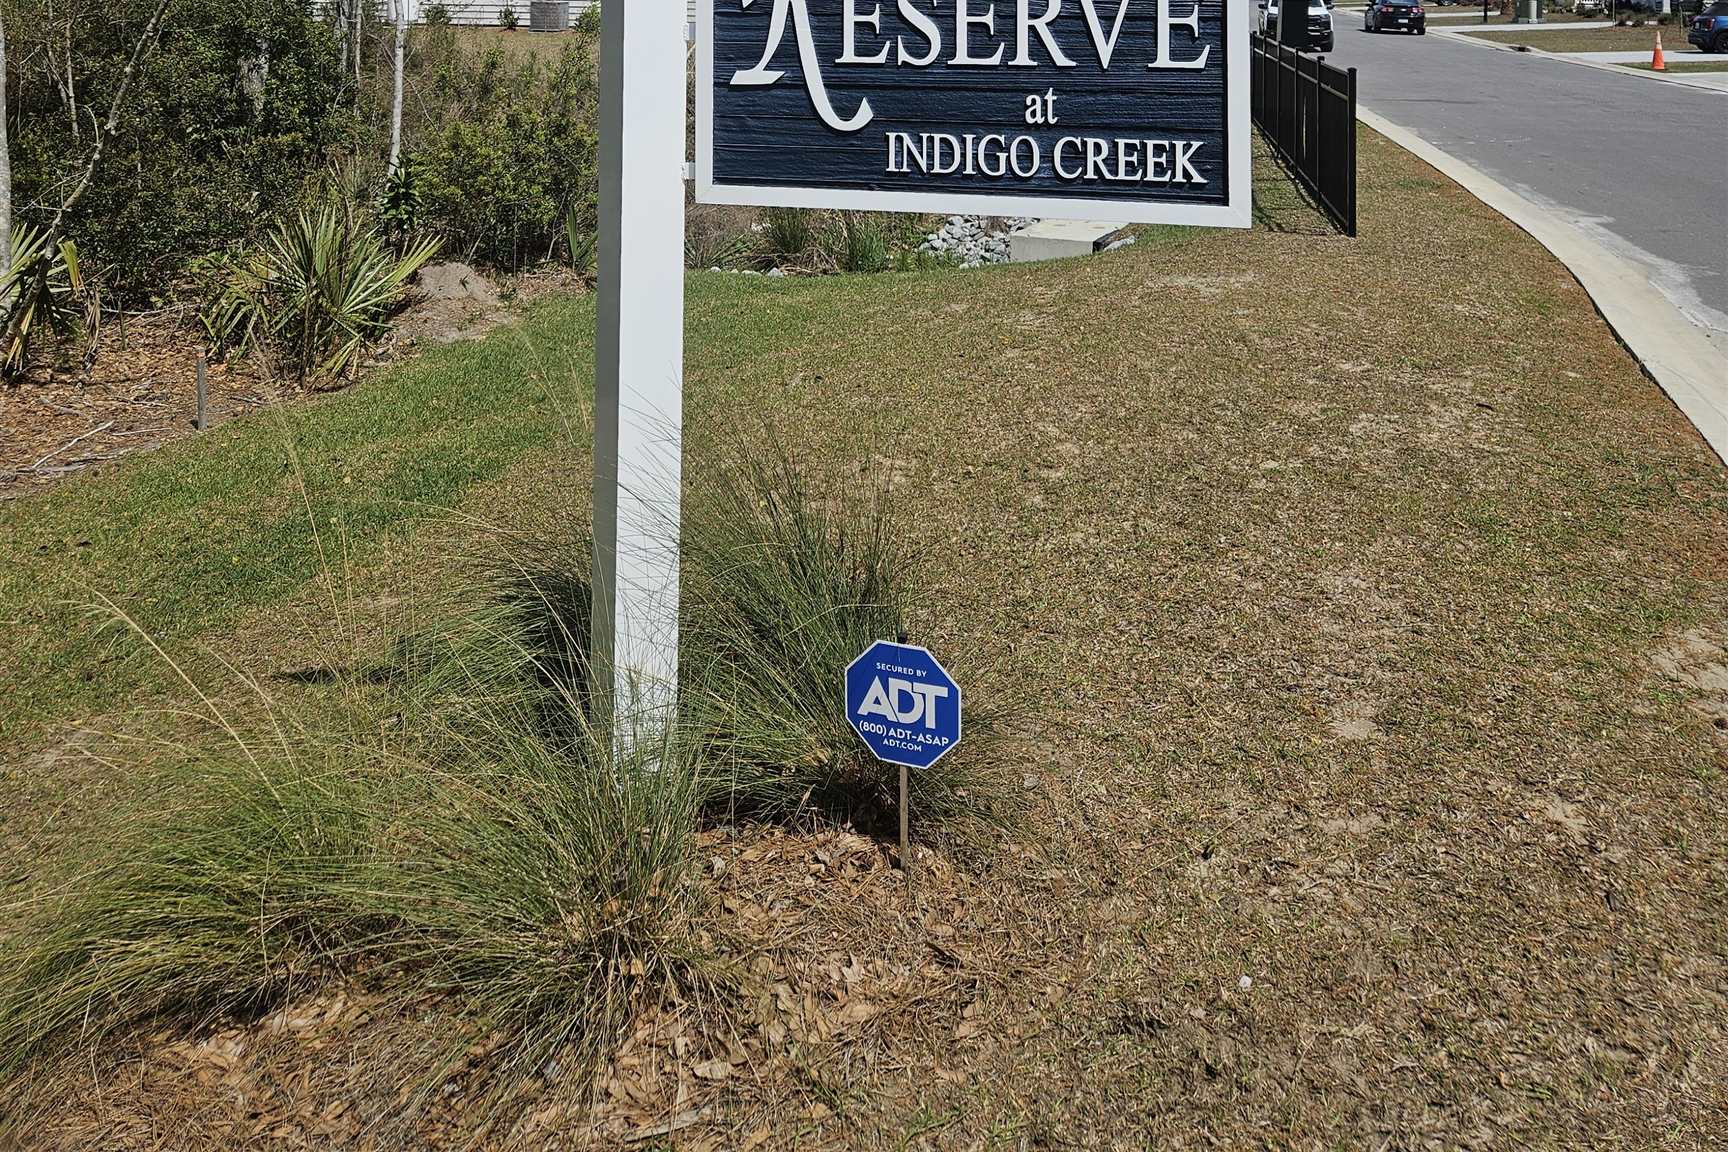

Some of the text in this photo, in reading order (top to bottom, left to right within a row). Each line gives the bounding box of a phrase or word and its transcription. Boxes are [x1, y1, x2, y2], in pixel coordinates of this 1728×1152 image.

[1025, 87, 1058, 125] at
[885, 132, 1208, 184] INDIGO CREEK
[875, 662, 914, 675] SECURED
[857, 675, 948, 729] ADT
[859, 720, 949, 747] (800) ADT-ASAP
[883, 738, 922, 752] ADT.COM
